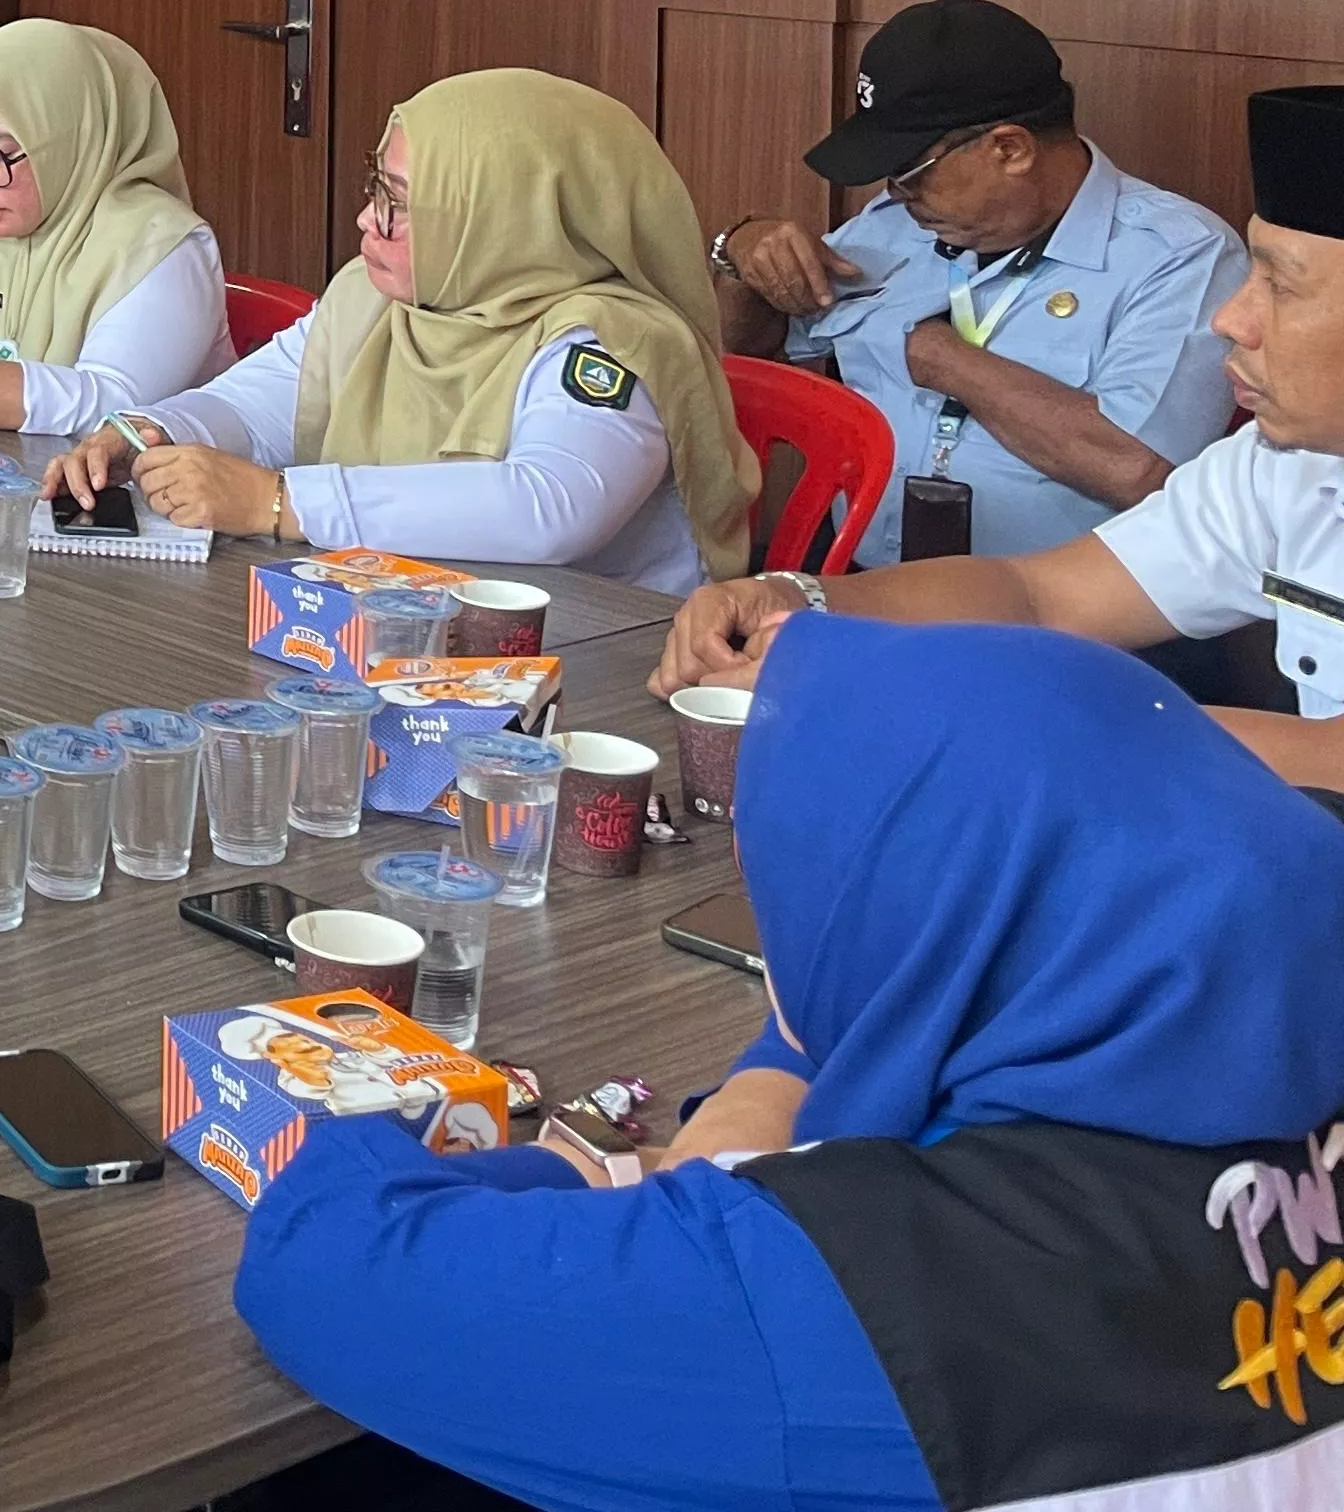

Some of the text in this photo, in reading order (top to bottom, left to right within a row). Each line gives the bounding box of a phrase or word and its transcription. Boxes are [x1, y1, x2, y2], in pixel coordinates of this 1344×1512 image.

[292, 585, 324, 605] thank
[298, 599, 318, 614] you
[401, 714, 449, 732] thank
[413, 730, 442, 746] you
[211, 1063, 248, 1102] thank
[219, 1086, 241, 1111] you
